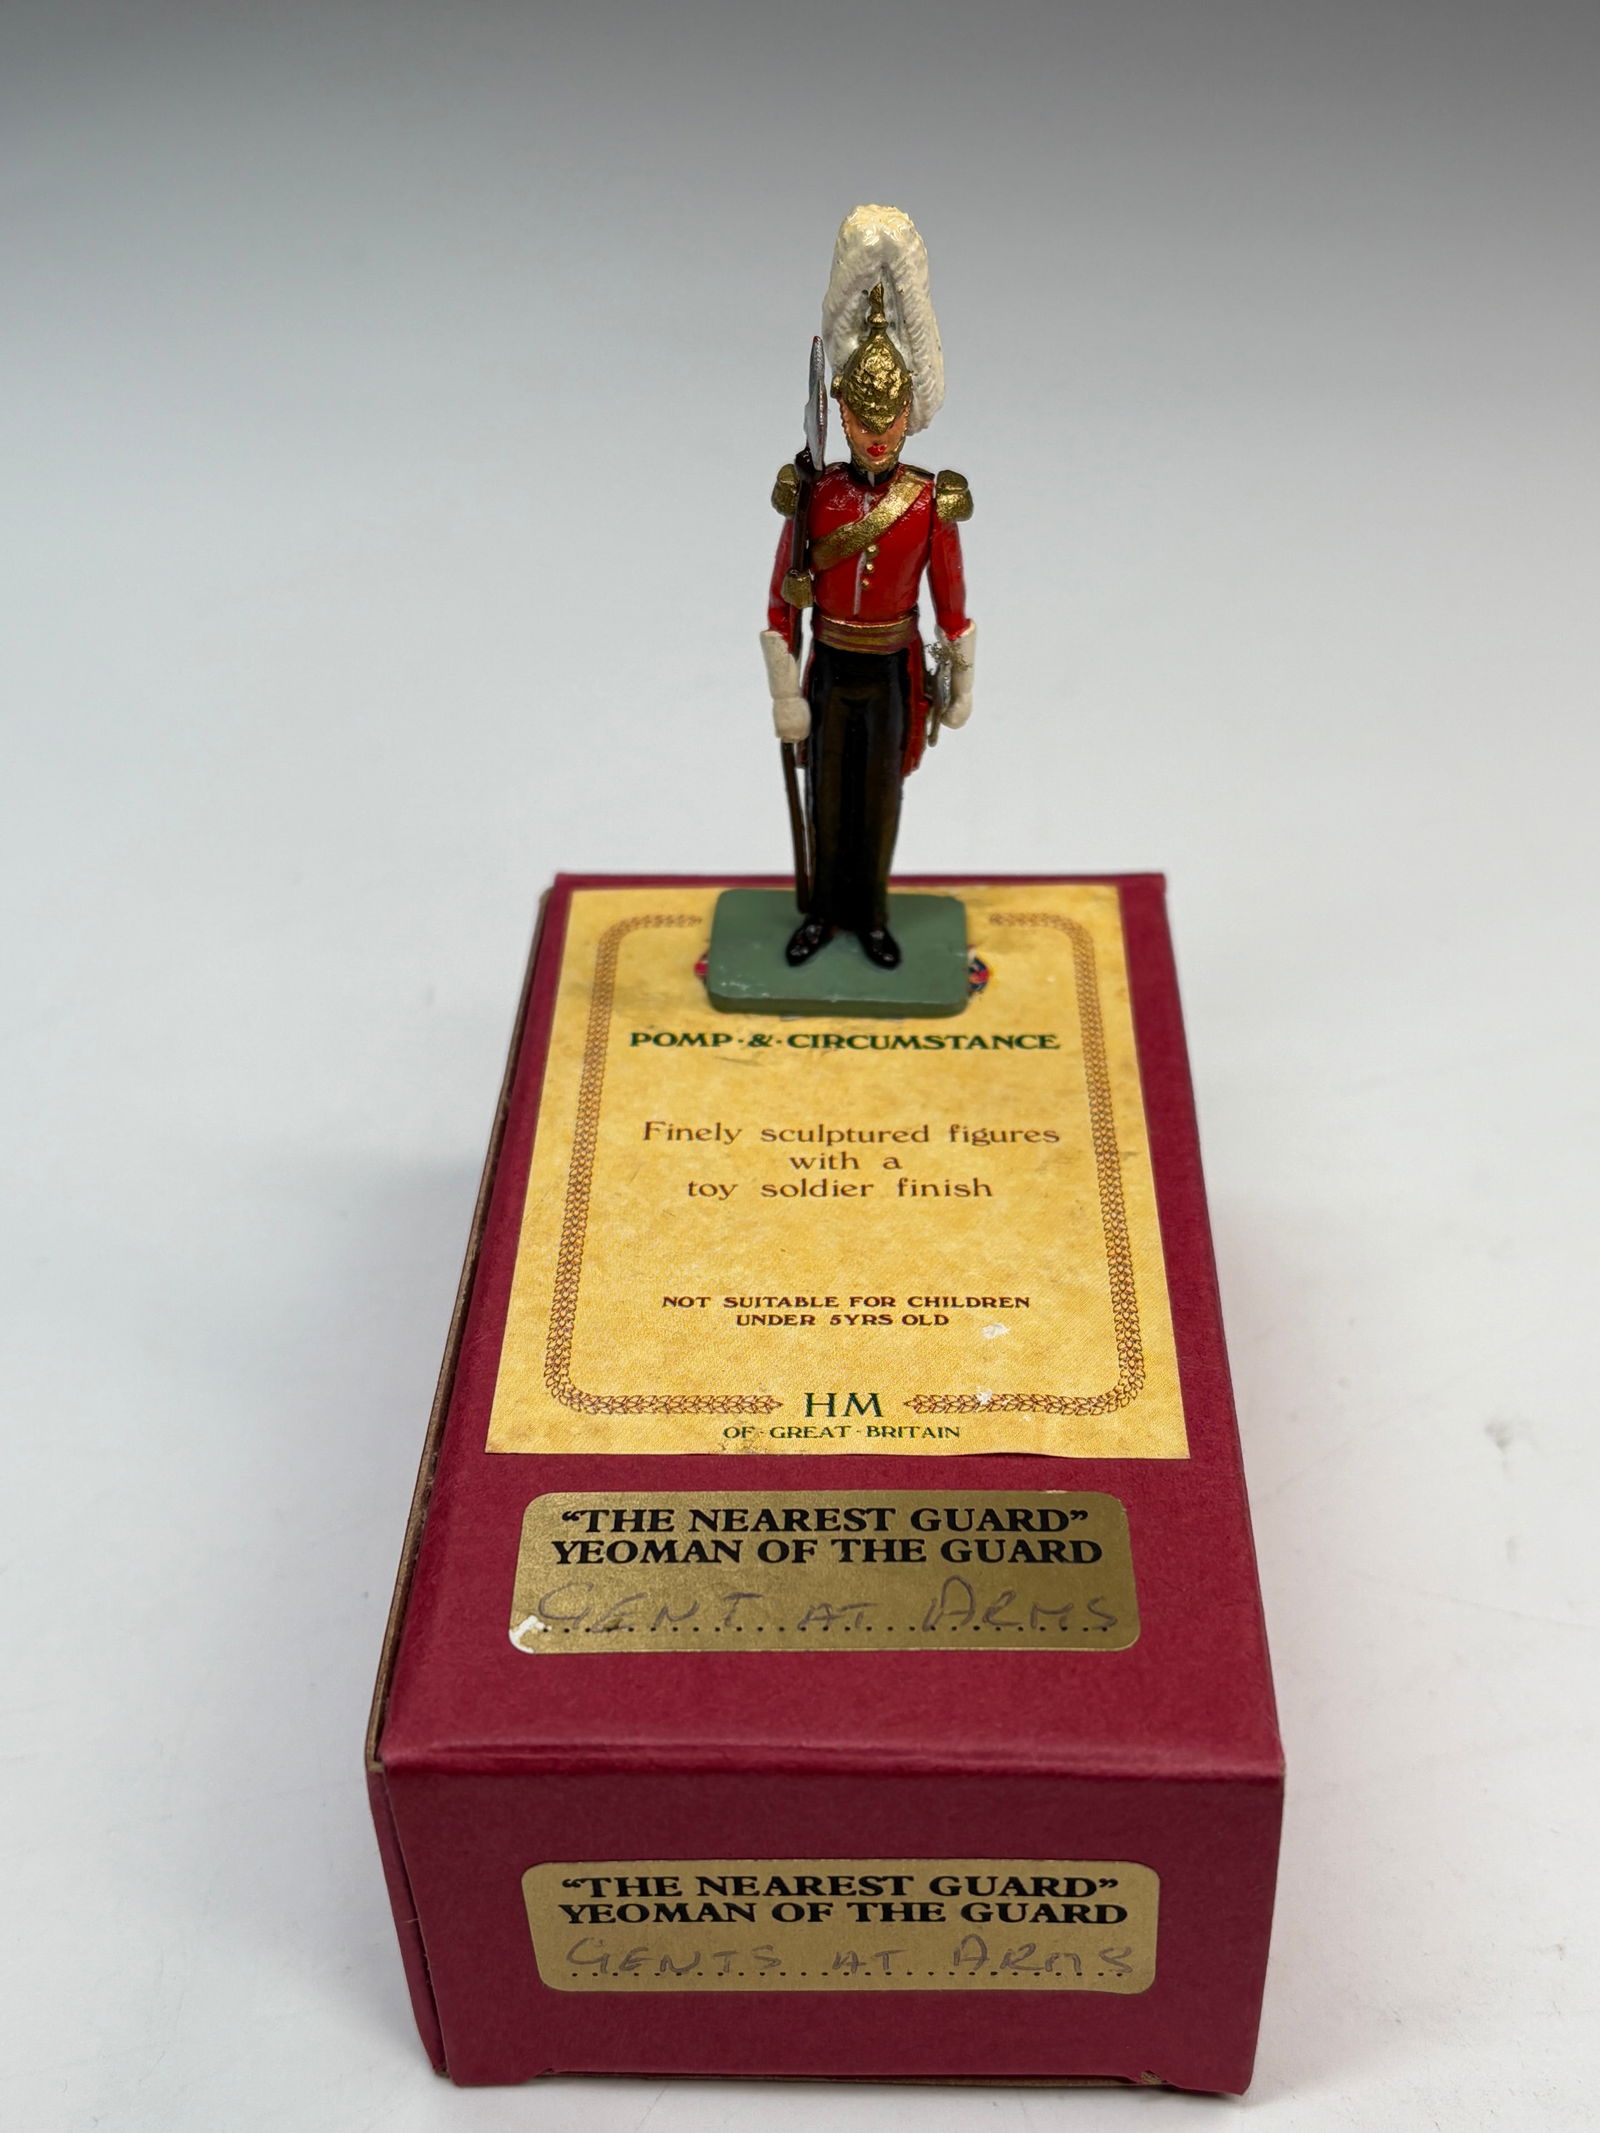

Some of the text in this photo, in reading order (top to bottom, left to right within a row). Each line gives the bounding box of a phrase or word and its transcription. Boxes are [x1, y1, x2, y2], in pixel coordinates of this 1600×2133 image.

[630, 1032, 733, 1049] POMP
[787, 1032, 1061, 1050] CIRCUMSTANCE
[643, 1120, 1060, 1147] Finely sculptured figures
[789, 1152, 902, 1170] with a
[687, 1178, 993, 1200] toy soldier finish
[662, 1296, 1030, 1308] NOT SUITABLE FOR CHILDREN
[736, 1314, 949, 1326] UNDER 5YRS OLD
[805, 1393, 883, 1418] HM
[723, 1425, 960, 1440] OF GREAT BRITAIN
[690, 1508, 897, 1533] NEAREST
[552, 1539, 1103, 1565] YEOMAN OF THE GUARD
[696, 1876, 913, 1897] NEAREST
[557, 1902, 1128, 1925] YEOMAN OF THE GUARD
